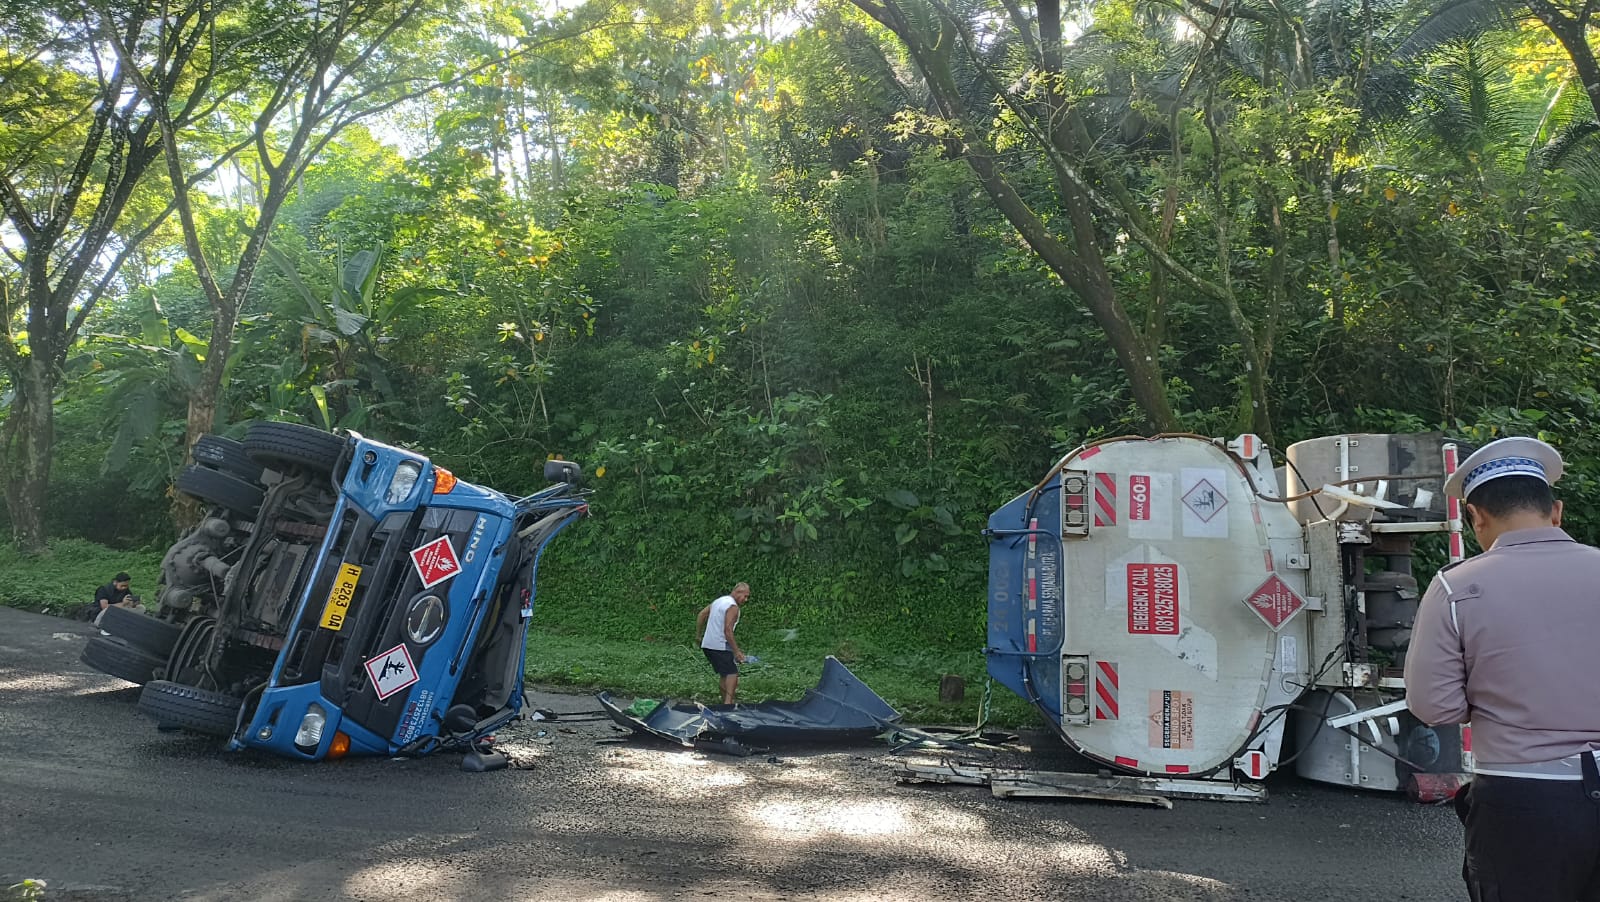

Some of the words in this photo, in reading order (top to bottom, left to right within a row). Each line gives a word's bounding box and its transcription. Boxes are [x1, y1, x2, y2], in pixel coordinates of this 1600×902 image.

[1132, 483, 1147, 503] 60
[1136, 502, 1144, 520] MAX
[465, 517, 487, 563] HINO
[346, 567, 360, 576] H
[1041, 551, 1056, 571] PUTRA
[1041, 572, 1056, 599] SENTANA
[1132, 568, 1148, 586] CALL
[335, 582, 353, 608] 8263
[1153, 566, 1174, 632] 081325738025
[1041, 599, 1056, 626] DHARMA
[1132, 587, 1149, 631] EMERGENCY
[402, 690, 429, 743] 081325738025
[418, 691, 435, 729] EMERGENCY
[1171, 697, 1180, 718] SPOT
[1171, 719, 1180, 744] BLIND
